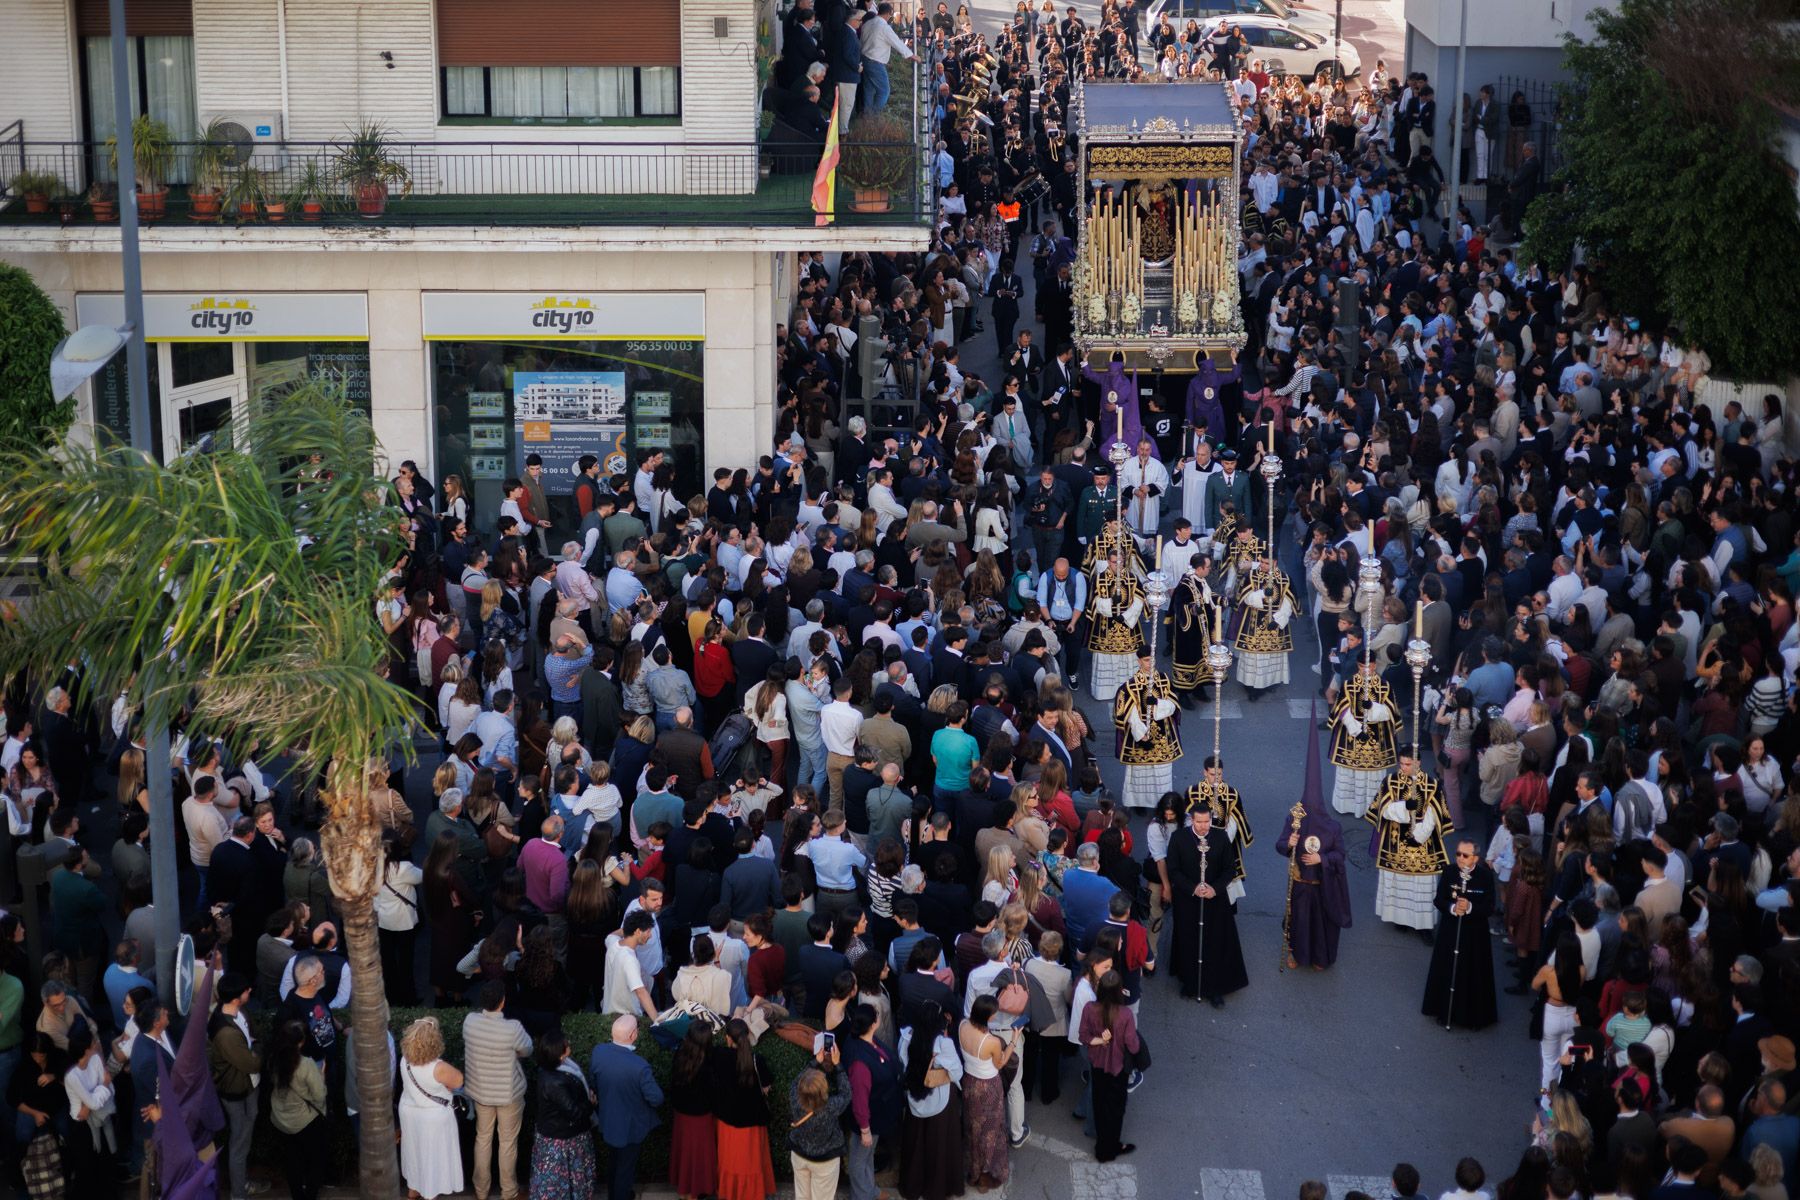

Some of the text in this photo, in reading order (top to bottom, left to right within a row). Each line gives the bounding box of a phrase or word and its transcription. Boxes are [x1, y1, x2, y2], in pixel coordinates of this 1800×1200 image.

[191, 310, 253, 334] city10
[532, 309, 594, 333] city10
[626, 341, 693, 351] 956 35 00 03
[104, 363, 121, 427] alquileres
[324, 389, 370, 398] inrsión
